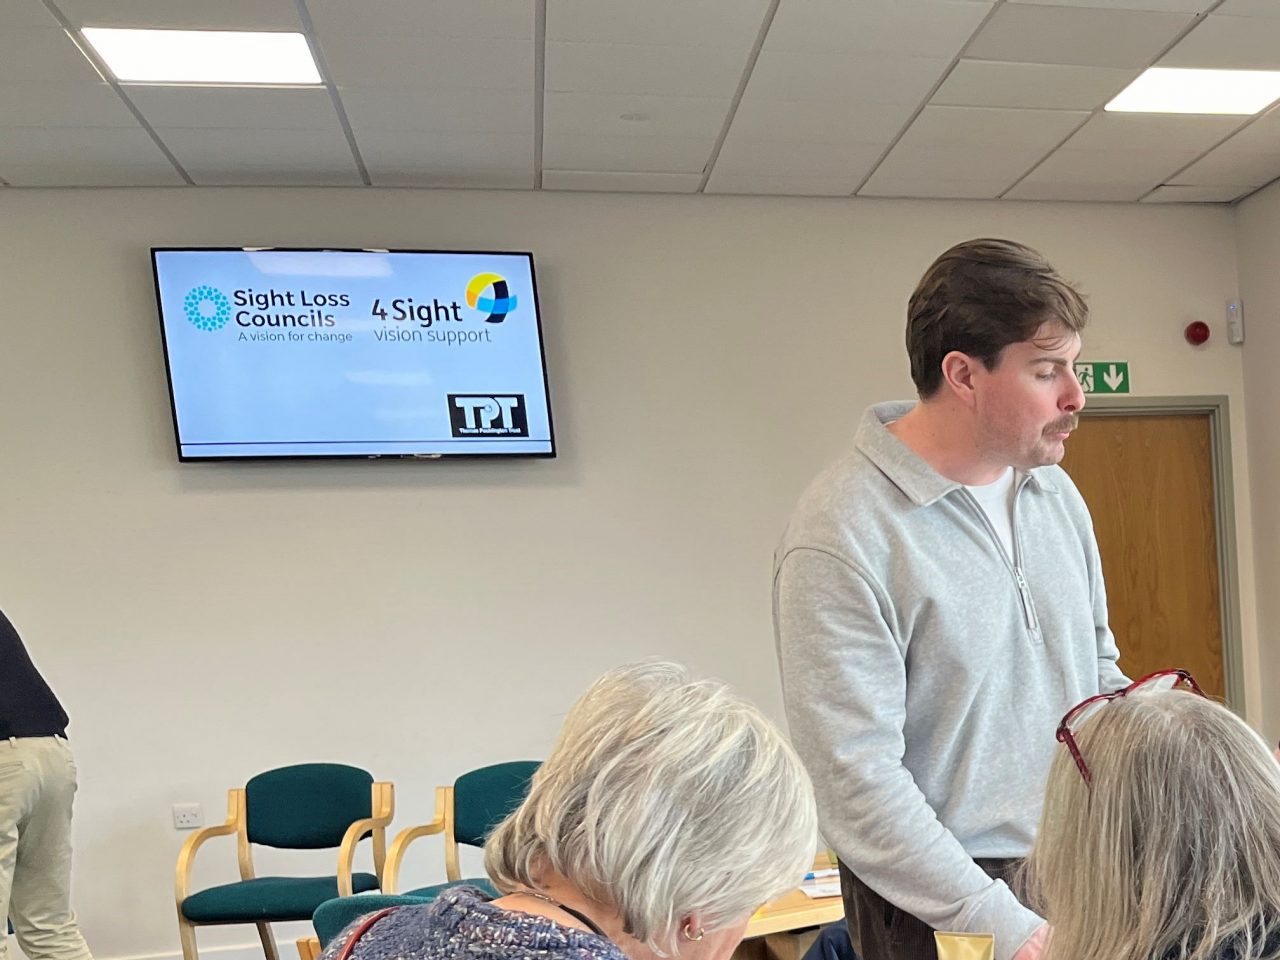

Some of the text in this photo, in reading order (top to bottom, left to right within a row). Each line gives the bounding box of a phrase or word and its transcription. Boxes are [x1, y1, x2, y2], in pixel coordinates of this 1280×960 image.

[233, 288, 350, 310] Sight Loss
[235, 309, 336, 327] Councils
[238, 331, 353, 344] A vision for change
[373, 325, 492, 346] vision support
[454, 396, 518, 429] TPT
